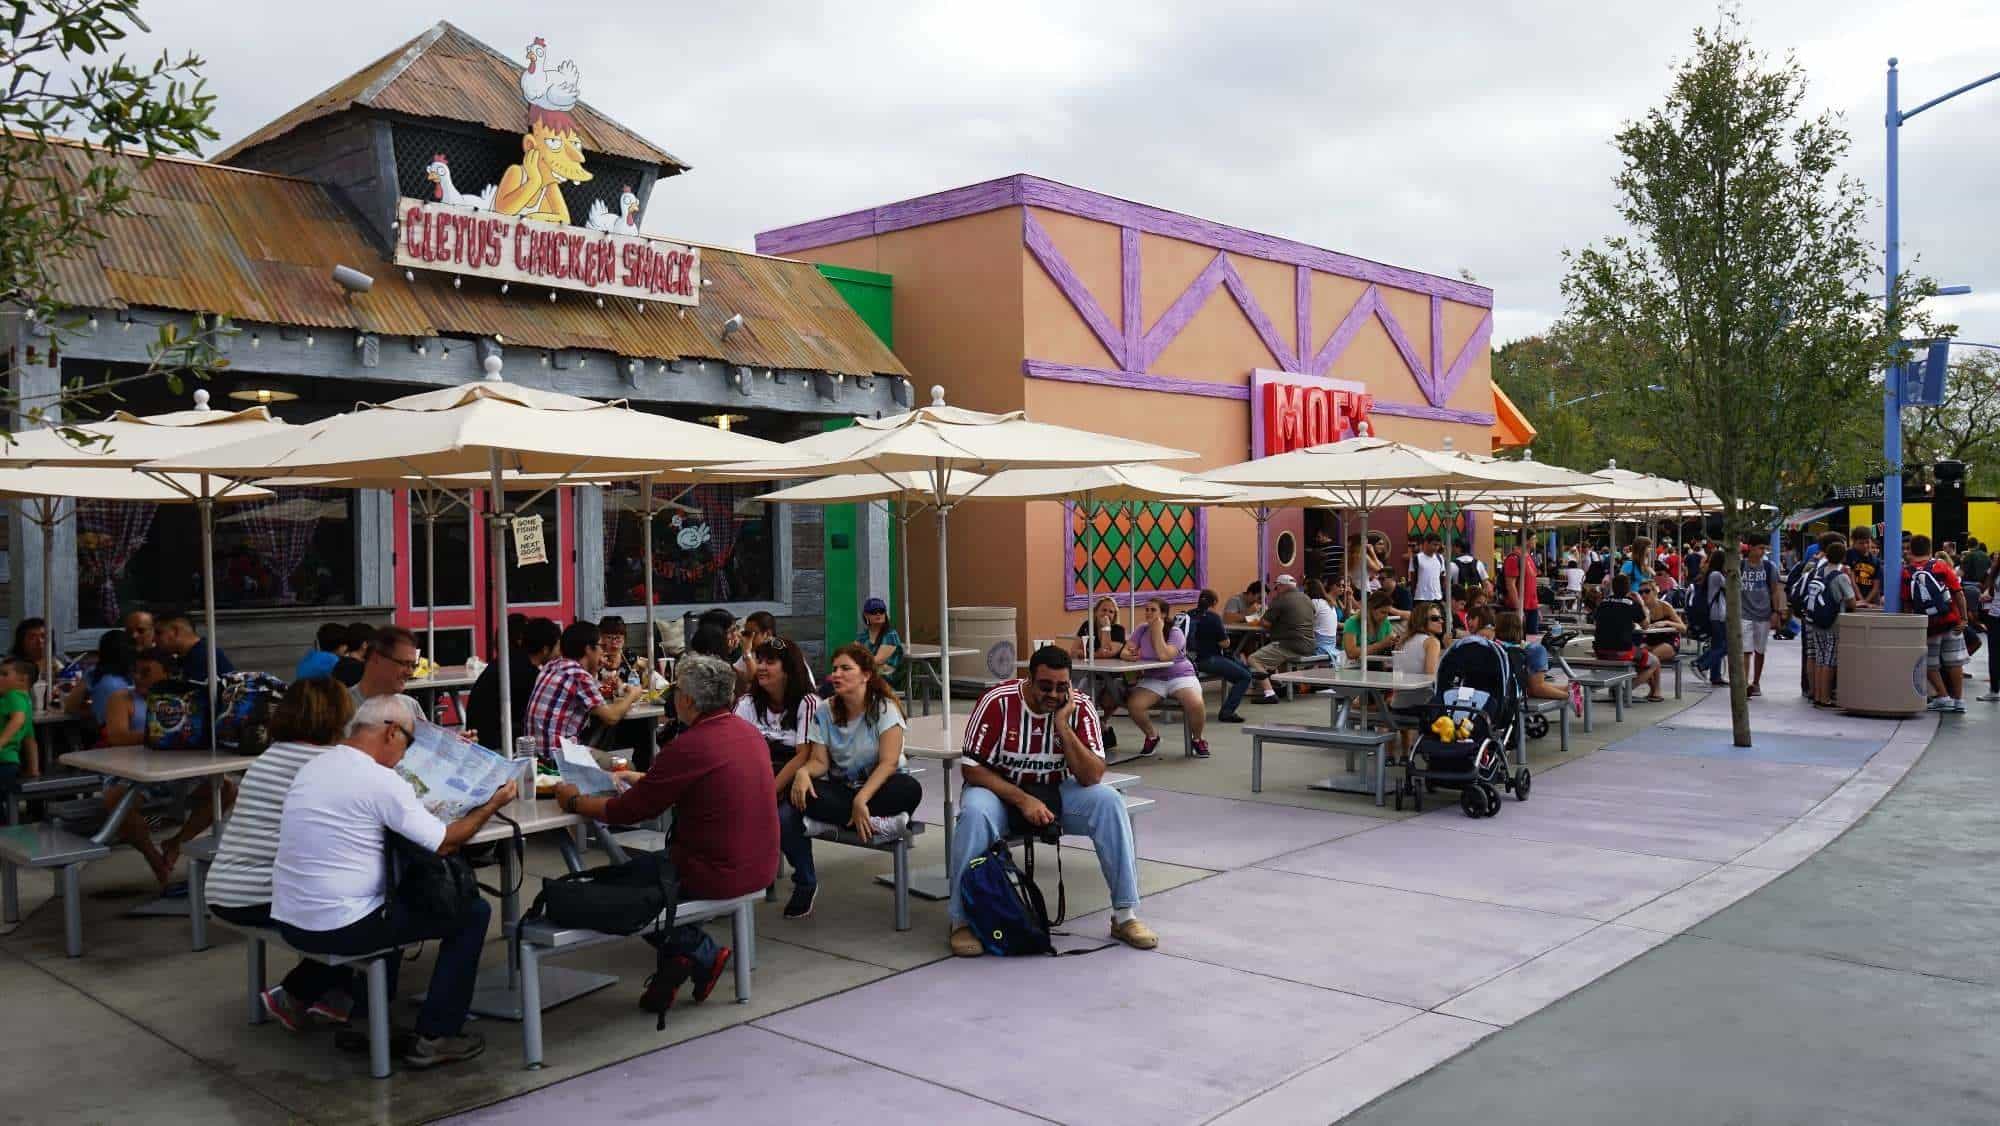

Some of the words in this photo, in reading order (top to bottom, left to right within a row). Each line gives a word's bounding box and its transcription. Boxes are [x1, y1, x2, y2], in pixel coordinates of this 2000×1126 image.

[406, 206, 509, 268] CLETUS'
[514, 222, 617, 287] CHICKEN
[622, 243, 695, 296] SHACK
[1002, 754, 1065, 770] Unimed
